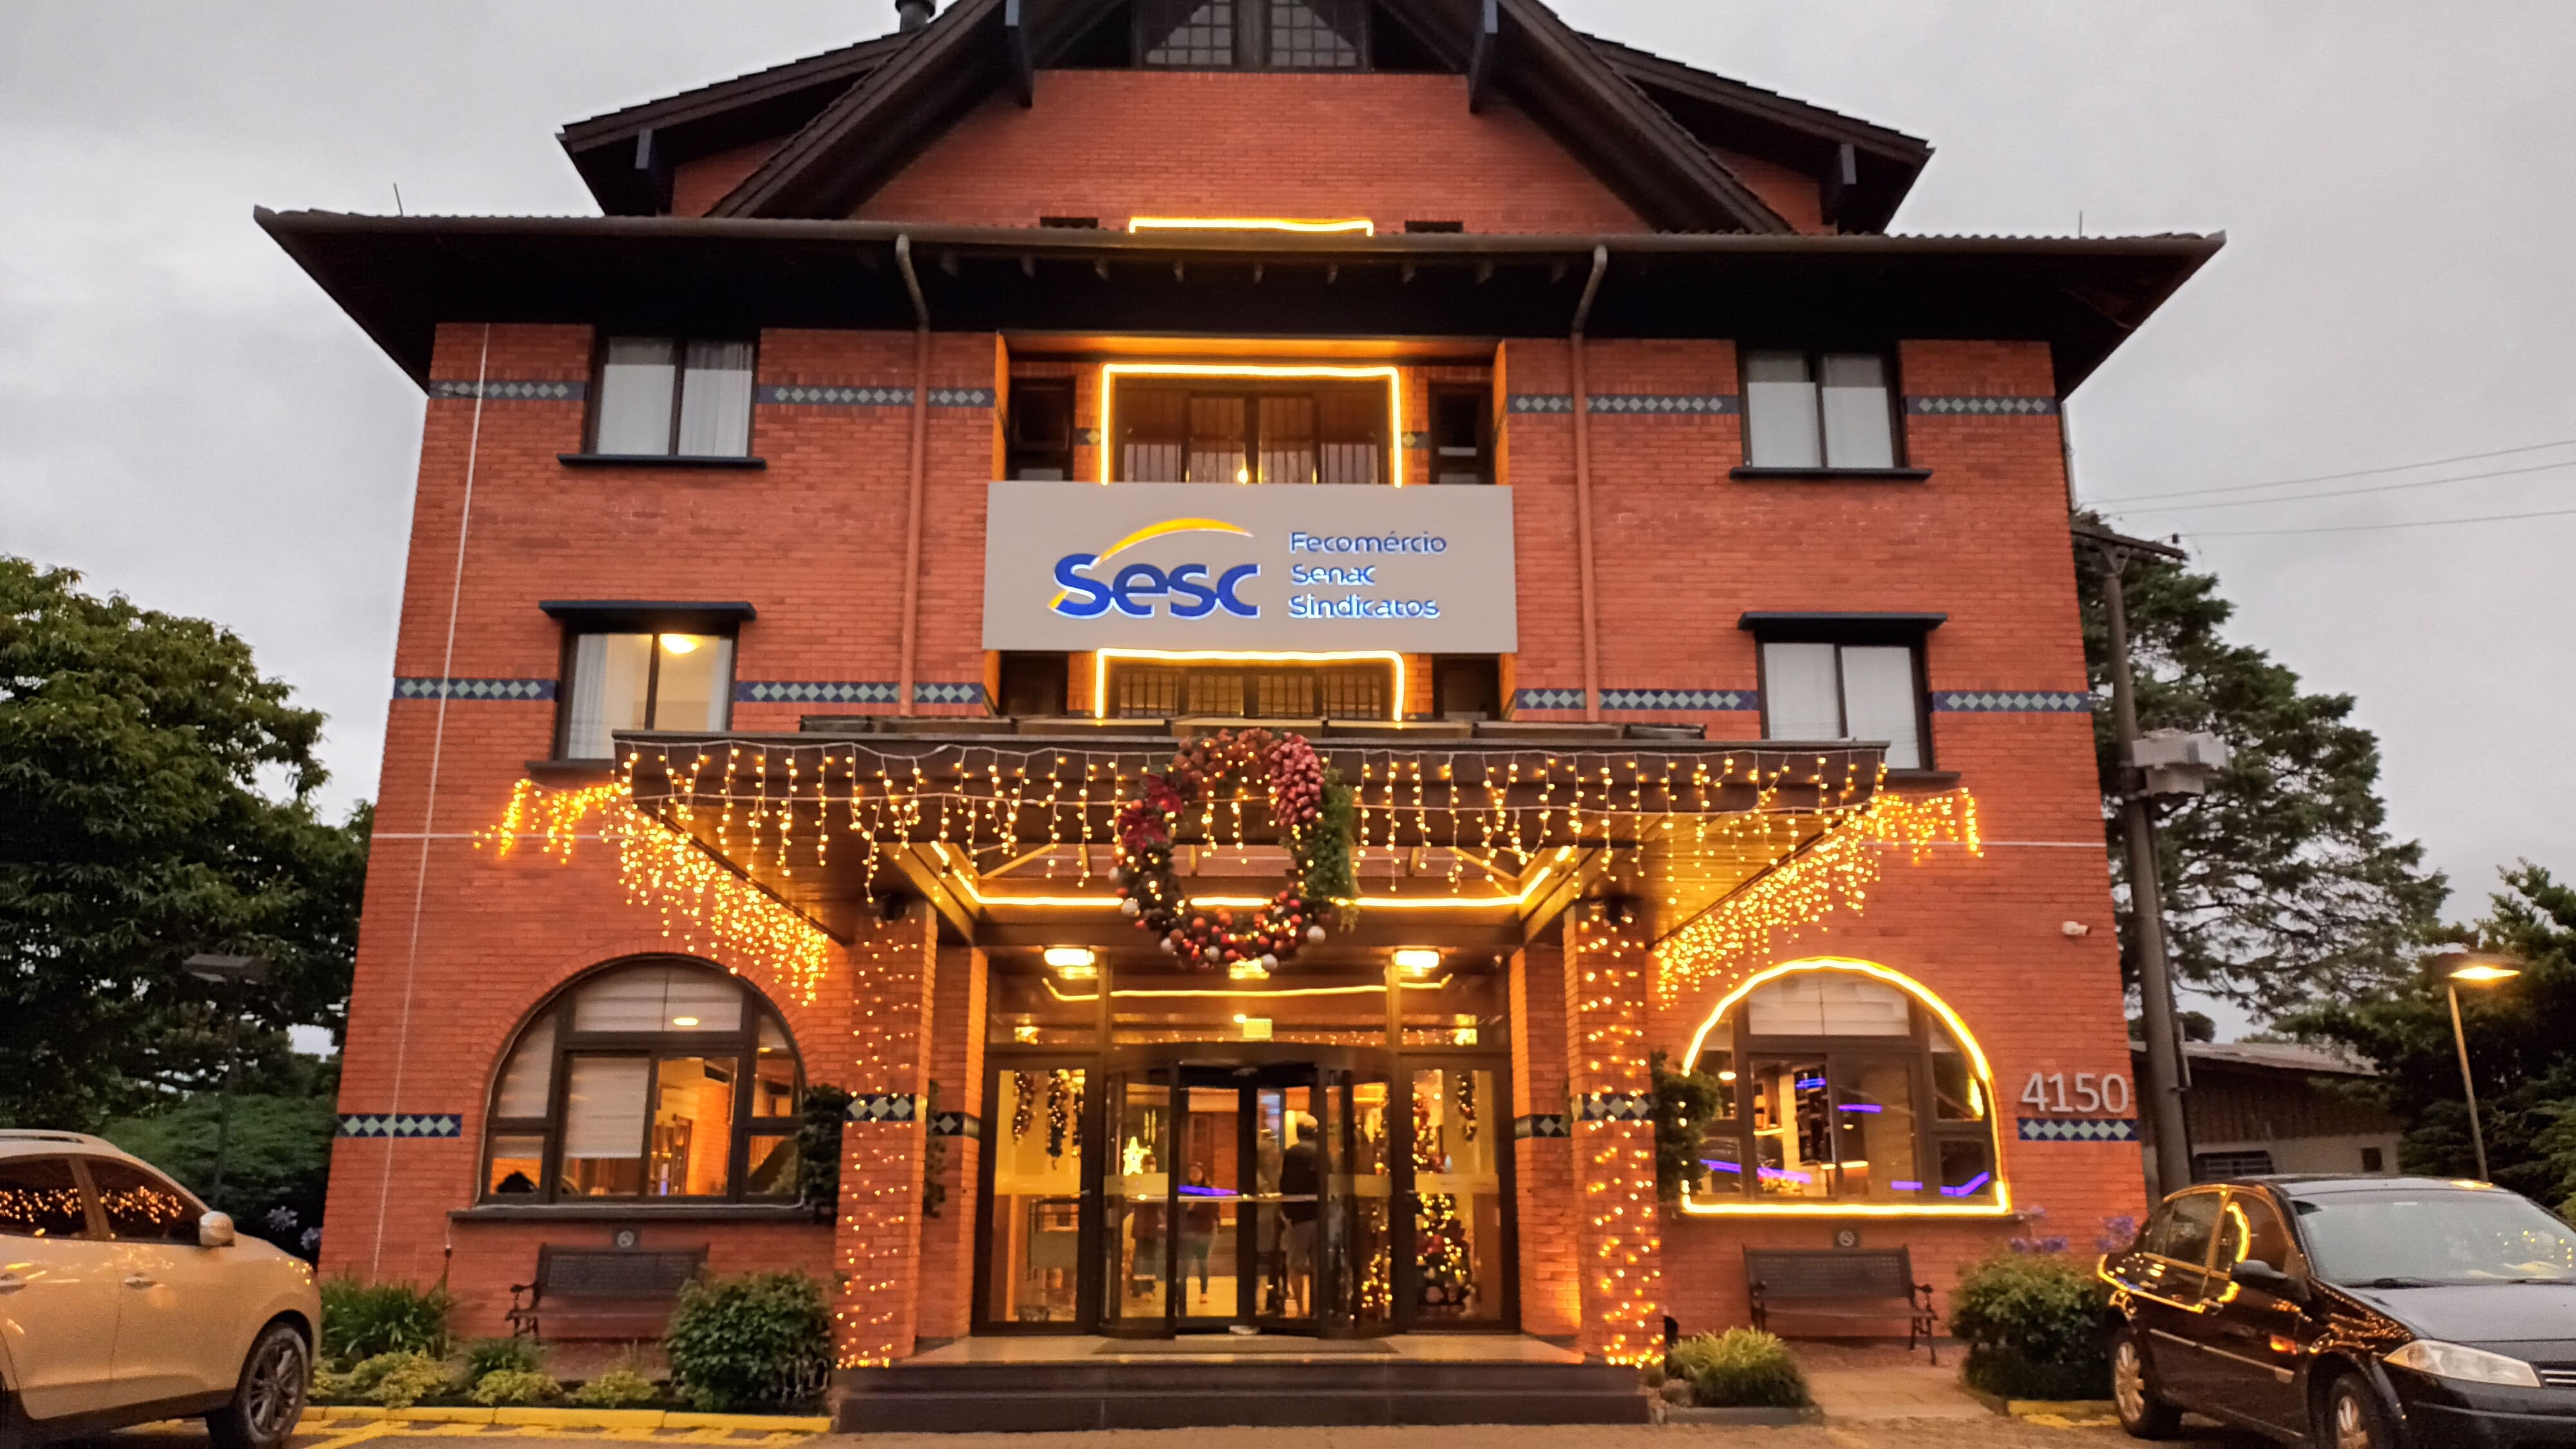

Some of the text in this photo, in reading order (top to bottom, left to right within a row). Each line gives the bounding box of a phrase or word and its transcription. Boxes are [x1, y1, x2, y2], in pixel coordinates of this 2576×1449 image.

[1289, 531, 1447, 554] Fecomércio
[1048, 553, 1261, 620] Sesc
[1291, 564, 1376, 586] Senac
[1288, 593, 1441, 618] Sindicatos
[2021, 1072, 2129, 1113] 4150
